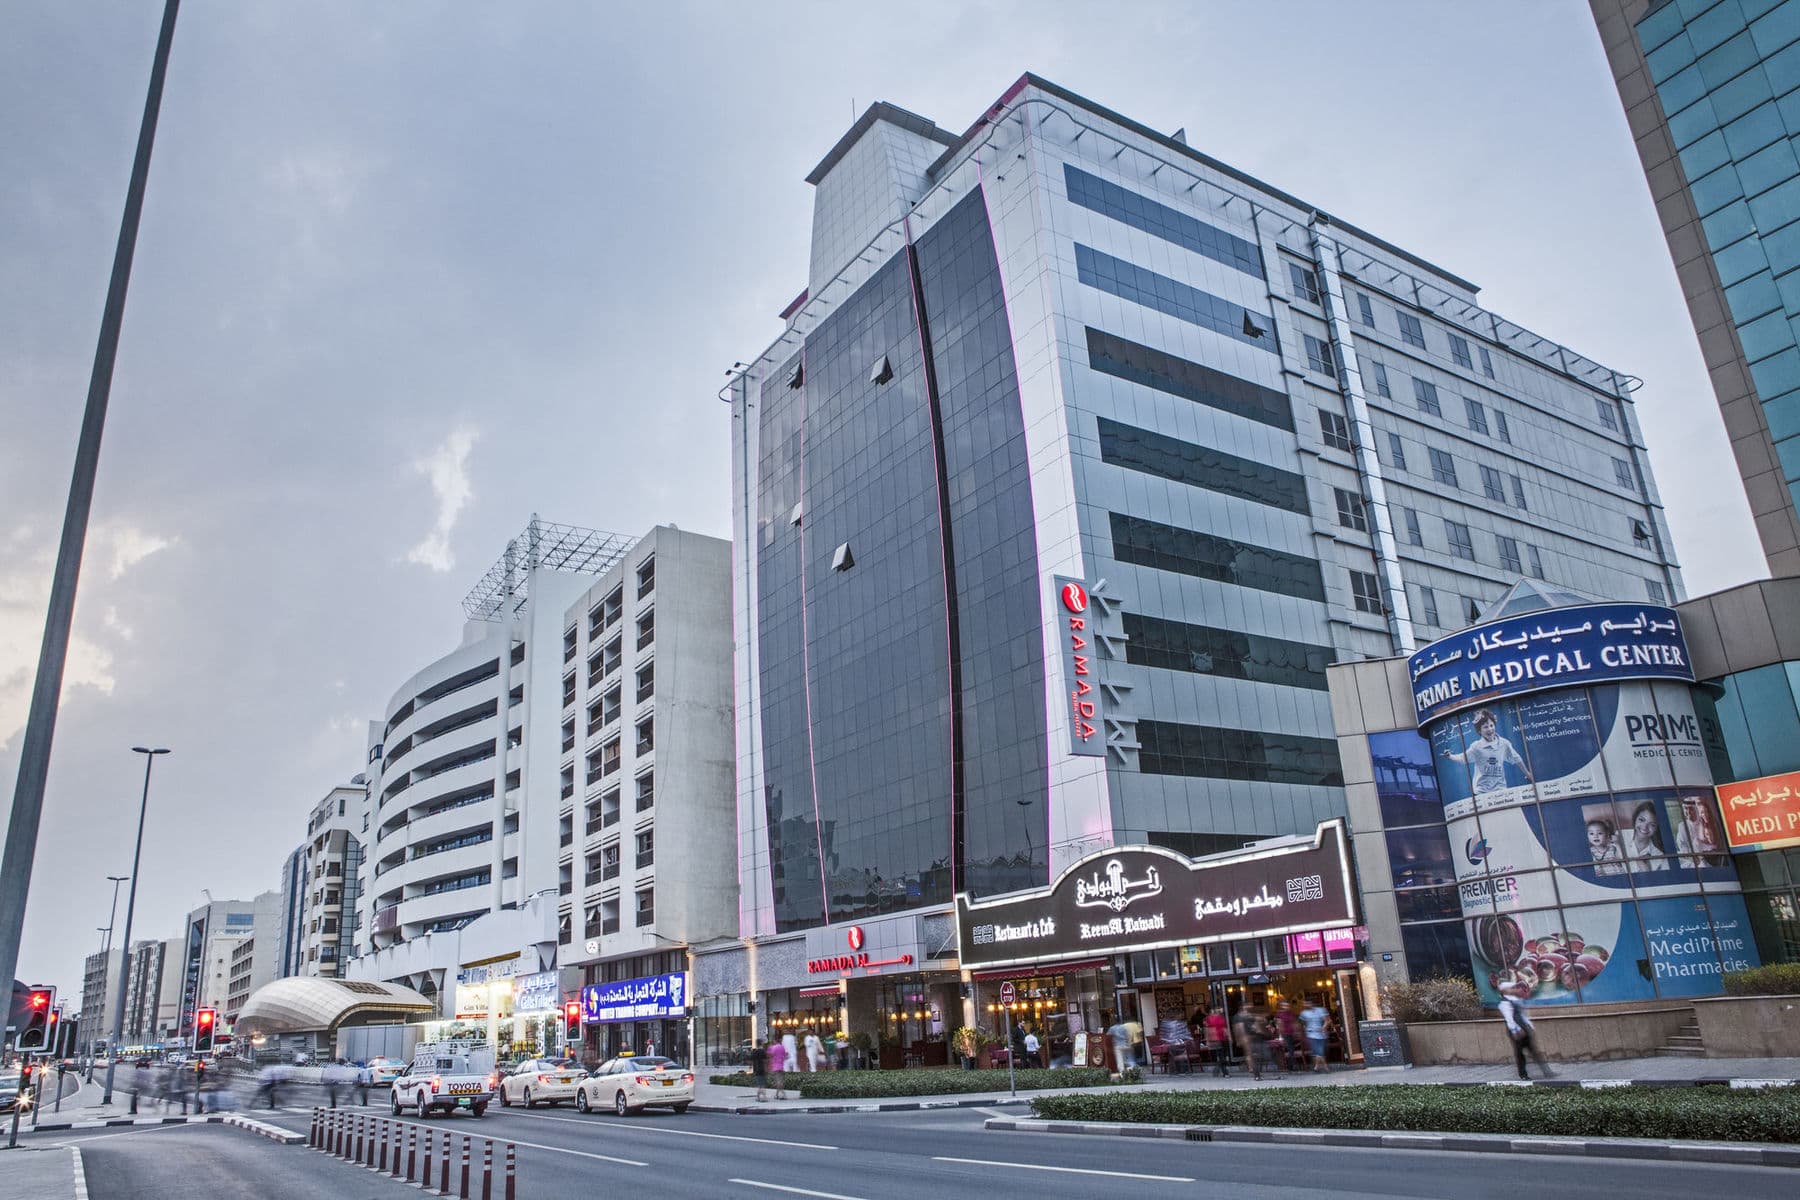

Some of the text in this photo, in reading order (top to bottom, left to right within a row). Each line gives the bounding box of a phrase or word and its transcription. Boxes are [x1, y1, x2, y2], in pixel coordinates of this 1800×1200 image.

[1413, 611, 1676, 683] برايم ميديكال سنتر
[1070, 617, 1097, 739] RAMADA
[1416, 644, 1685, 712] PRIME MEDICAL CENTER
[1562, 714, 1593, 723] Services
[1625, 714, 1699, 742] PRIME
[1525, 728, 1581, 742] Multi-Locations
[1634, 748, 1703, 759] MEDICL CENTER
[1730, 786, 1790, 811] برايم
[1736, 811, 1800, 837] MEDI P
[1461, 877, 1518, 899] PREMIER
[1463, 896, 1492, 909] Diagnostic
[1033, 922, 1040, 938] &
[1080, 922, 1110, 939] Reem
[1124, 913, 1165, 935] Bawadi
[1646, 925, 1675, 938] برايم
[1650, 937, 1744, 957] MediPrime
[807, 955, 855, 974] RAMADA
[1654, 959, 1750, 979] Pharmacies
[448, 1082, 482, 1091] TOYOTA
